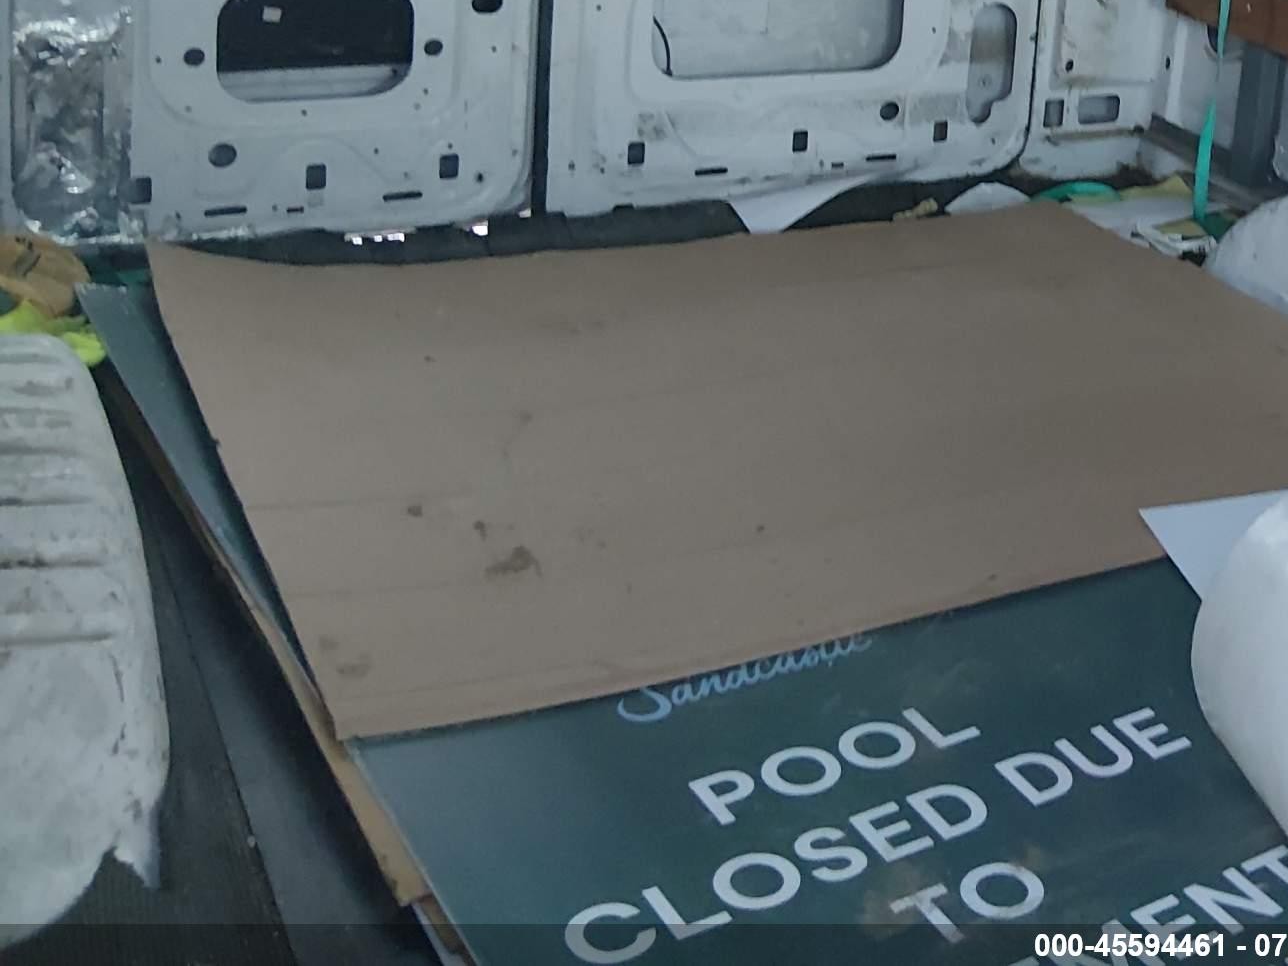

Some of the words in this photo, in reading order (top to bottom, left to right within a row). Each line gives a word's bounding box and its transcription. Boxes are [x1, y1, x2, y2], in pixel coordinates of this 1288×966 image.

[687, 706, 982, 826] POOL
[565, 784, 988, 964] CLOSED
[994, 707, 1192, 807] DUE
[889, 861, 1046, 945] TO
